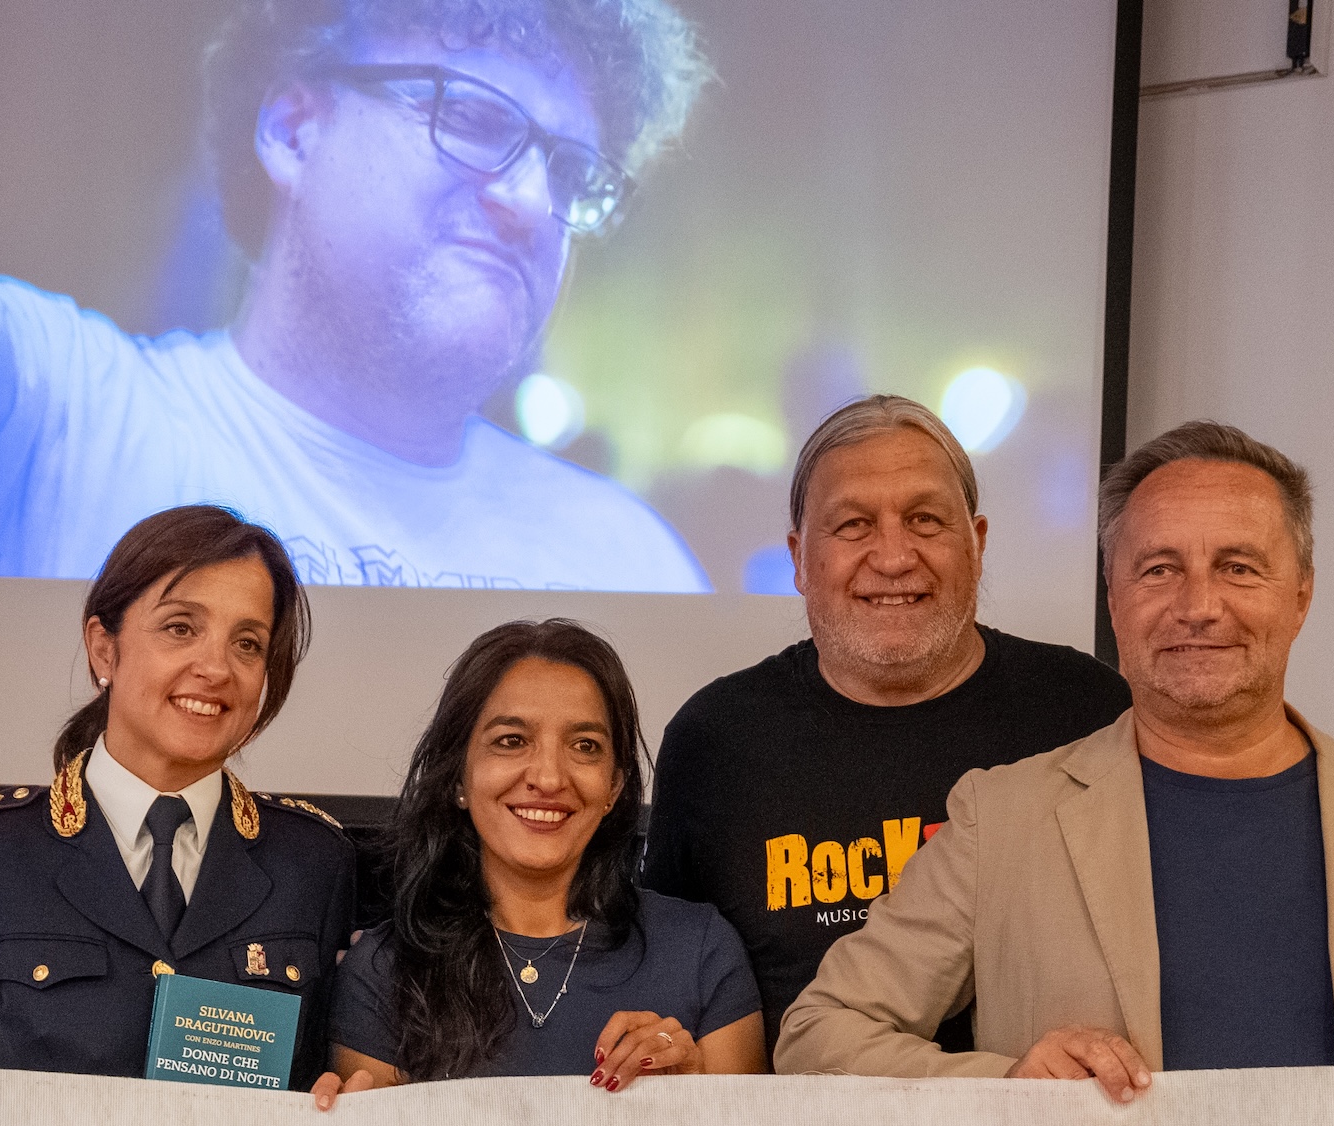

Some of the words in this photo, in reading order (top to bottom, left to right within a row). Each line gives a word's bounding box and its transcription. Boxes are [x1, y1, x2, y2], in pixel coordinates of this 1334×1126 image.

[199, 1005, 255, 1025] SILVANA
[175, 1016, 276, 1043] DRAGUTINOVIC
[185, 1034, 201, 1043] CON
[202, 1037, 222, 1047] ENZO
[223, 1041, 261, 1053] MARTINES
[182, 1047, 230, 1065] DONNE
[232, 1056, 260, 1070] CHE
[156, 1057, 217, 1077] PENSANO
[219, 1068, 235, 1080] DI
[236, 1071, 281, 1088] NOTTE
